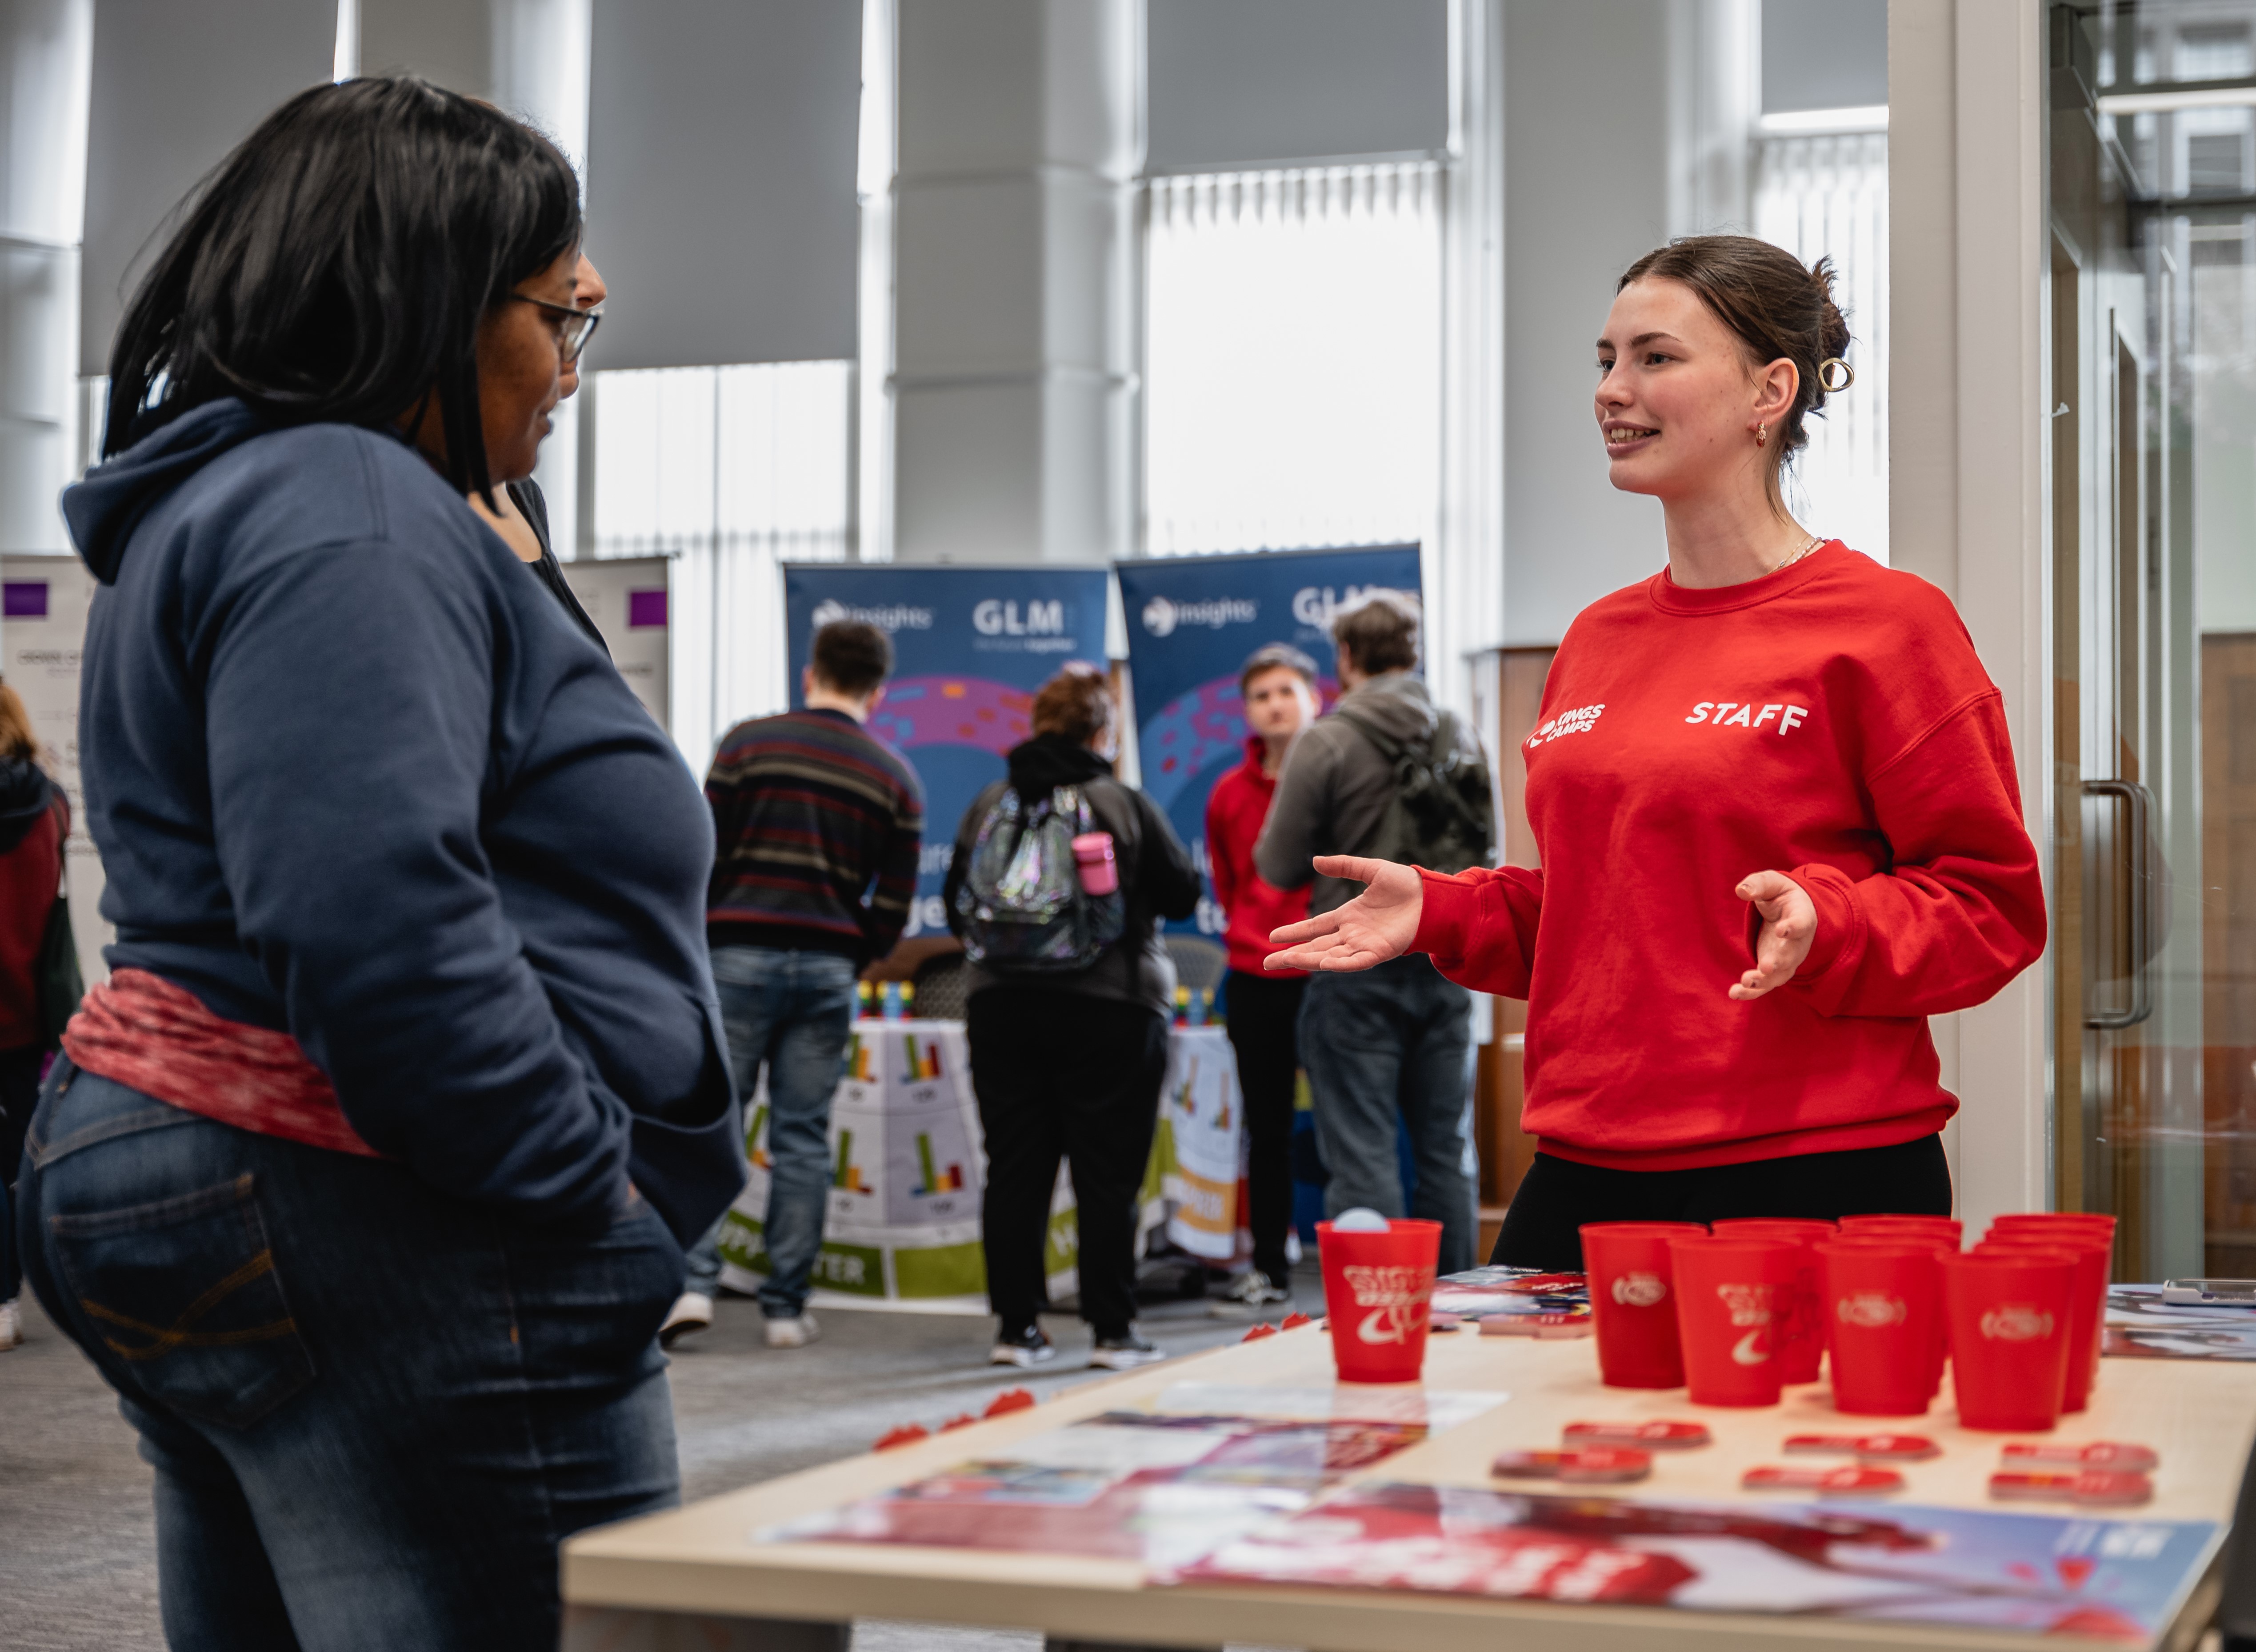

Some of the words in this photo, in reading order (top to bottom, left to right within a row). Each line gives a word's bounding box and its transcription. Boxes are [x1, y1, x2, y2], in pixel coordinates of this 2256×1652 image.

[972, 599, 1064, 636] GLM
[1179, 598, 1257, 629] insights
[1546, 719, 1596, 743] CAMPS
[1558, 704, 1606, 727] KINGS
[1685, 702, 1808, 736] STAFF
